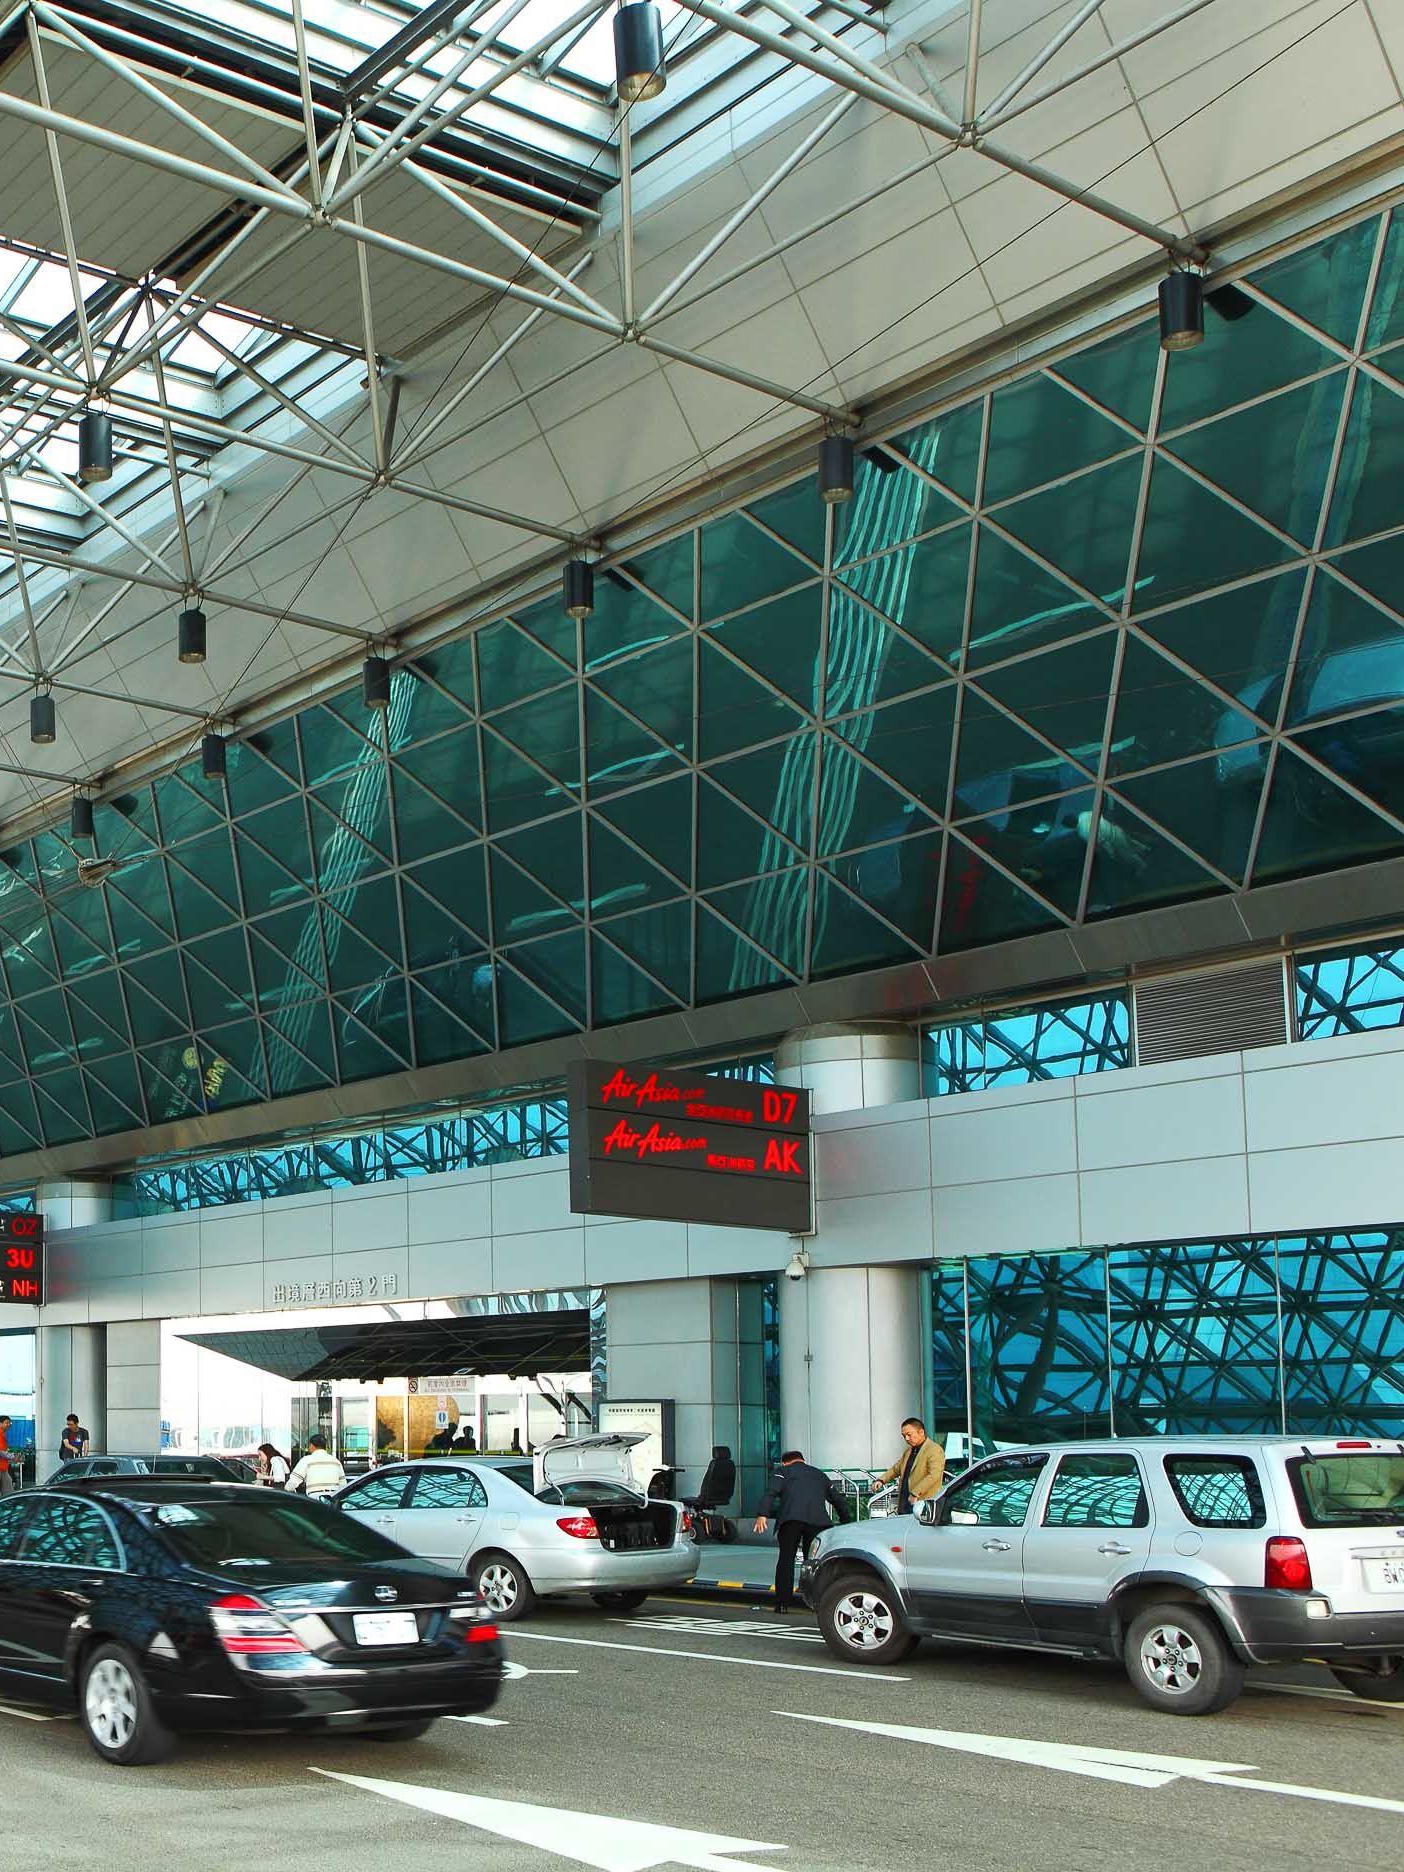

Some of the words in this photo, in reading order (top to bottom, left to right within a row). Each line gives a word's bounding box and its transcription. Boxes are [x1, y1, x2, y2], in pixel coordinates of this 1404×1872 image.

[763, 1089, 798, 1124] D7
[763, 1139, 802, 1175] AK
[11, 1216, 37, 1236] OZ
[6, 1248, 35, 1270] 3U
[12, 1279, 39, 1297] NH
